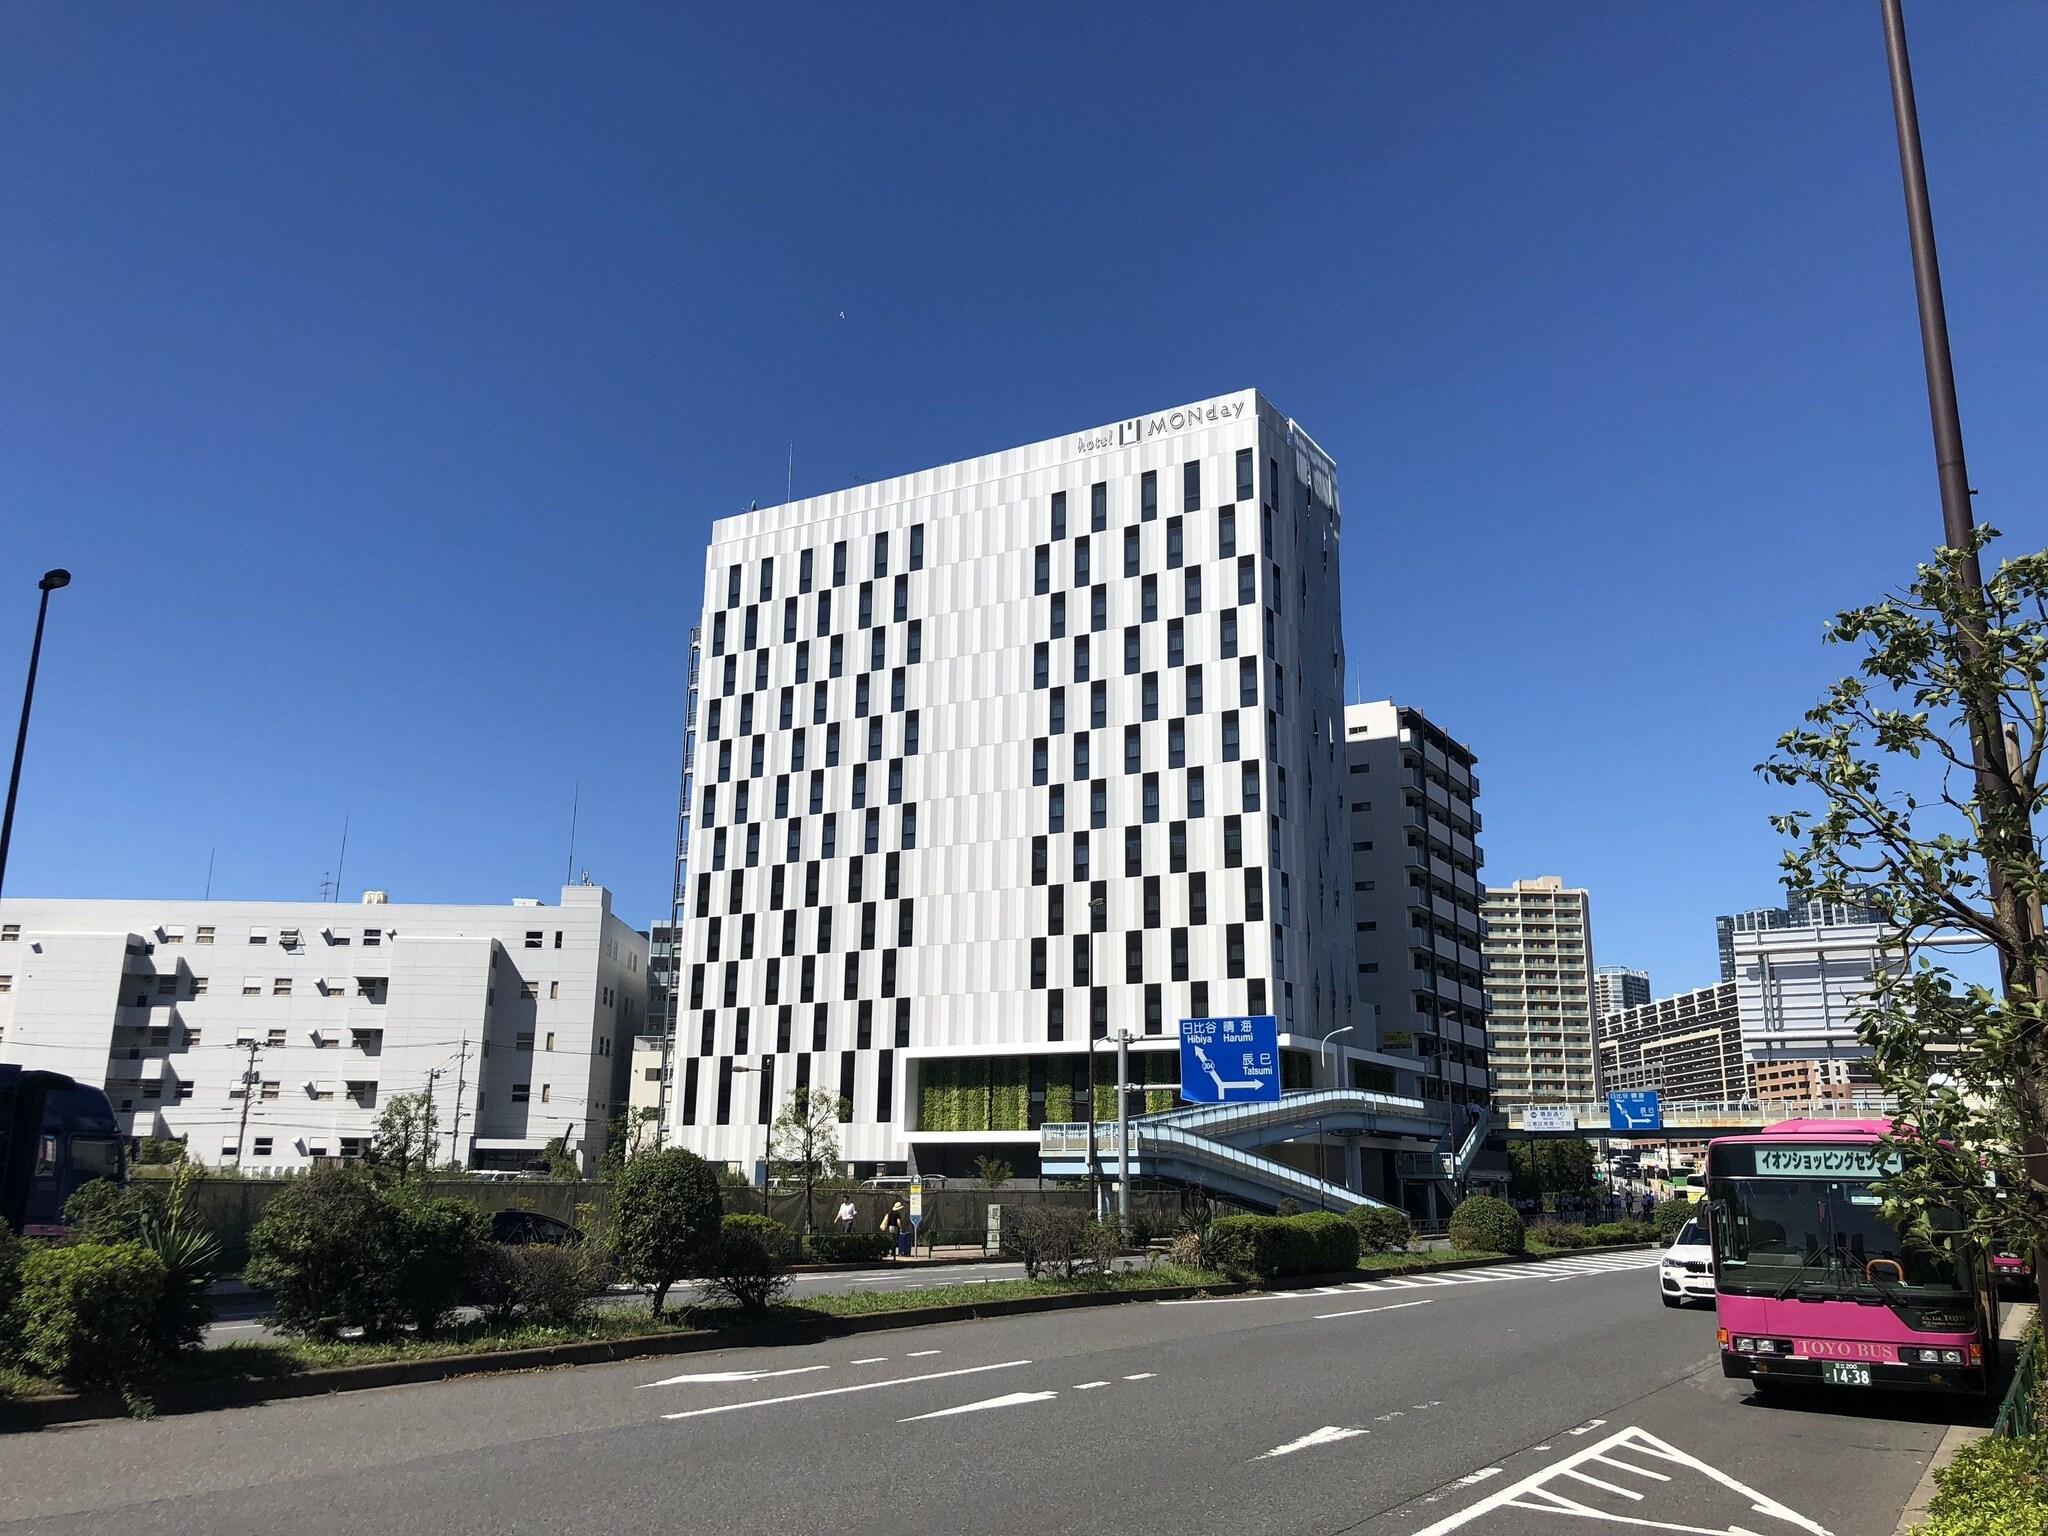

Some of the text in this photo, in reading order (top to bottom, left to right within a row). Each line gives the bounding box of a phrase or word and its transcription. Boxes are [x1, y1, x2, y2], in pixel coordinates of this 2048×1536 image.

[1077, 401, 1245, 454] hotel MONday
[1182, 1021, 1217, 1035] 日比谷
[1223, 1020, 1252, 1033] 晴海
[1187, 1035, 1213, 1045] Hibiya
[1223, 1033, 1254, 1043] Harumi
[1242, 1053, 1272, 1066] 辰巳
[1243, 1066, 1273, 1076] Tatsumi
[1762, 1151, 1898, 1171] イオンショッピングセンー
[1798, 1340, 1892, 1358] TOYO BUS
